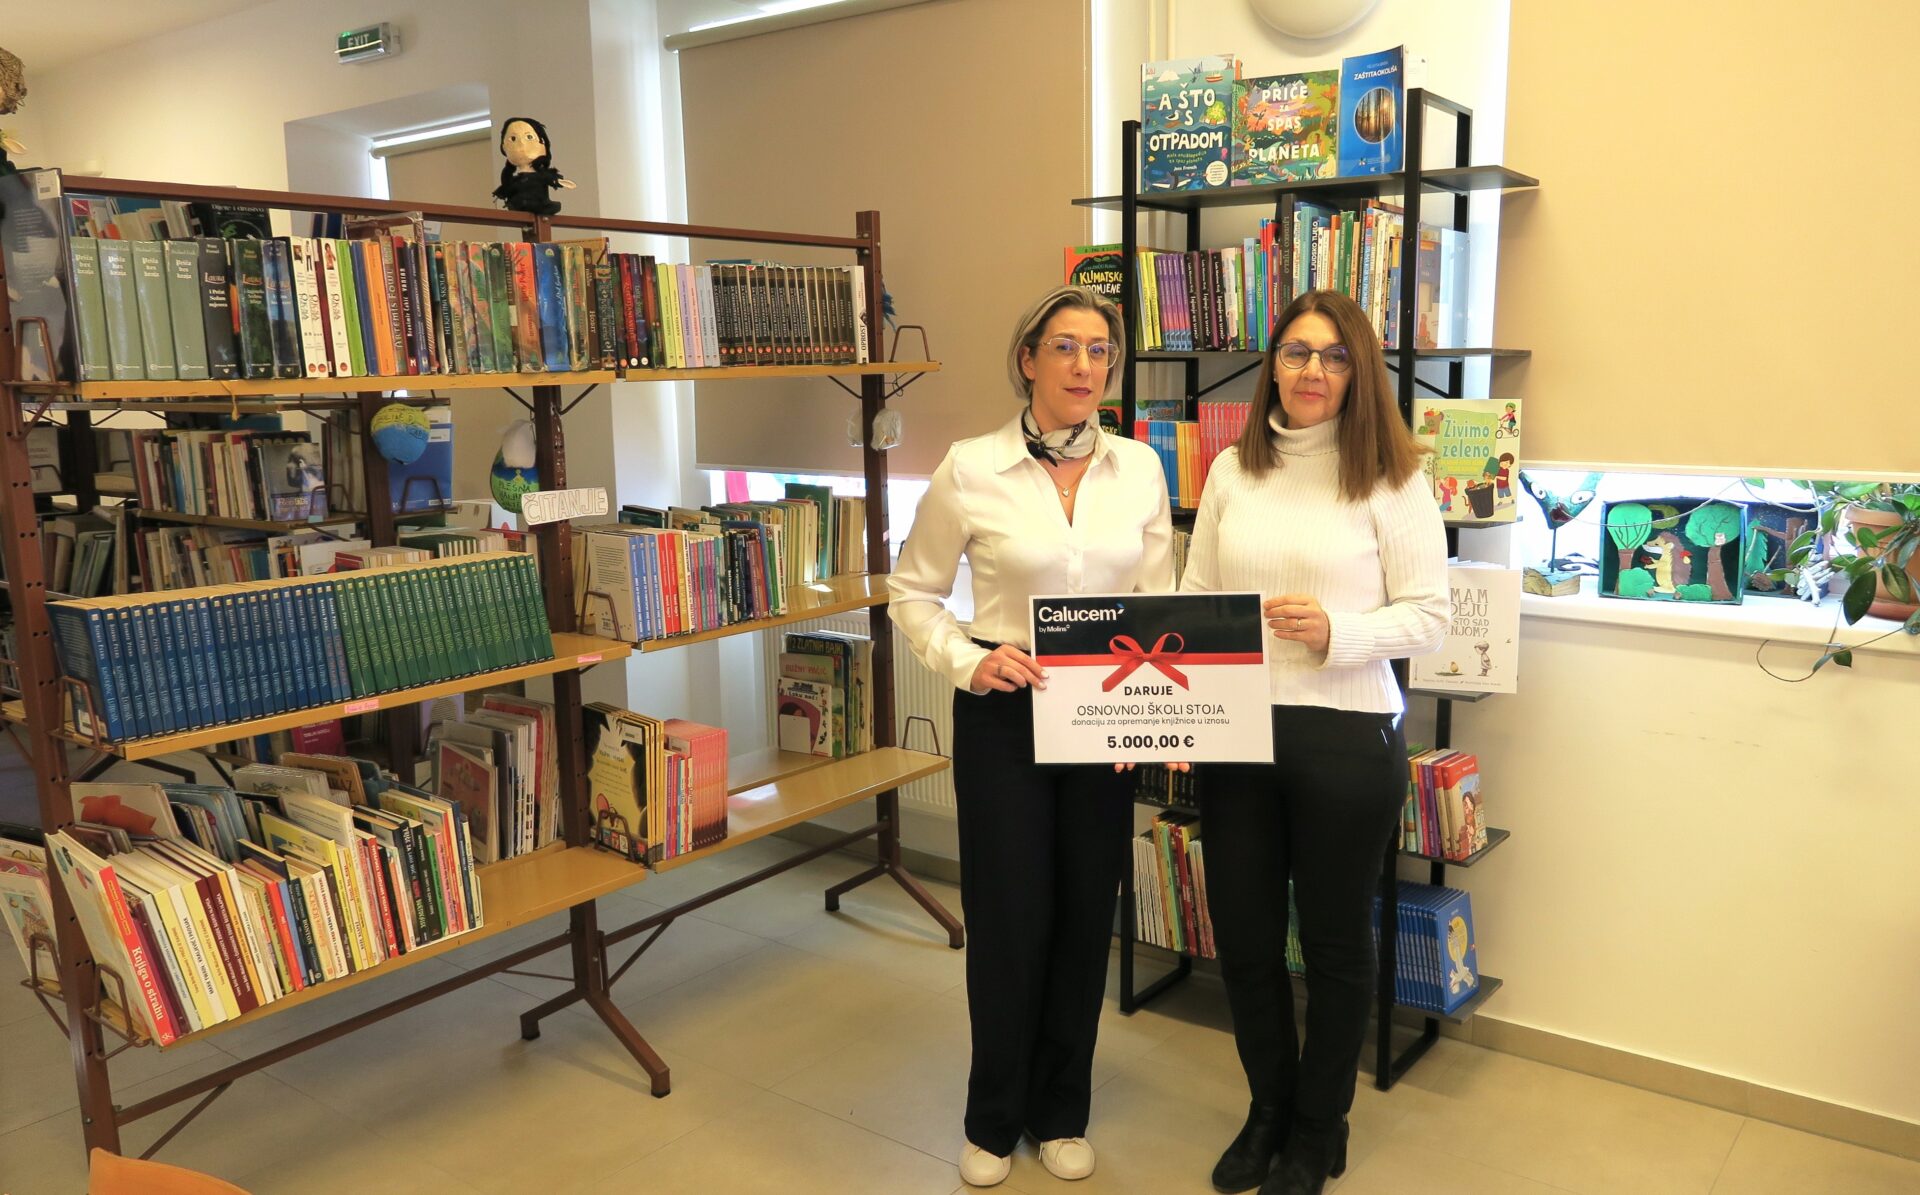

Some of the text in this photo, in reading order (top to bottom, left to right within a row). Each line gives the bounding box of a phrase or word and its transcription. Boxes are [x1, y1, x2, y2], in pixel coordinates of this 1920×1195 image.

[348, 34, 369, 48] EXIT
[1354, 65, 1397, 80] ZAŠTITA OKOLIŠA
[1159, 83, 1215, 110] A ŠTO
[1262, 84, 1308, 102] PRIČE
[1184, 111, 1193, 126] S
[1267, 117, 1302, 131] SPAS
[1149, 132, 1223, 151] OTPADOM
[1249, 143, 1320, 161] PLANETA
[1309, 221, 1319, 270] LJUDSKO TIJELO
[204, 272, 225, 284] Laura
[384, 268, 397, 299] FOWL
[1079, 270, 1122, 283] KLIMATSKE
[1444, 414, 1490, 439] Živimo
[1443, 444, 1490, 458] zeleno
[524, 488, 606, 523] ČITANJE
[1039, 606, 1116, 622] Calucem
[1472, 618, 1489, 626] SAD
[1124, 686, 1173, 696] DARUJE
[1077, 702, 1224, 716] OSNOVNOJ ŠKOLI STOJA
[1072, 718, 1105, 726] donaciju
[1118, 718, 1160, 726] opremanje
[1162, 716, 1195, 725] knjižnice
[1107, 735, 1194, 750] 5.000,00 €
[405, 843, 412, 851] ZA
[182, 917, 194, 937] PROSJAK
[189, 939, 204, 962] KRALJEVIĆ
[199, 964, 209, 980] TWAIN
[132, 947, 149, 983] Knjiga
[145, 989, 163, 1020] strahu
